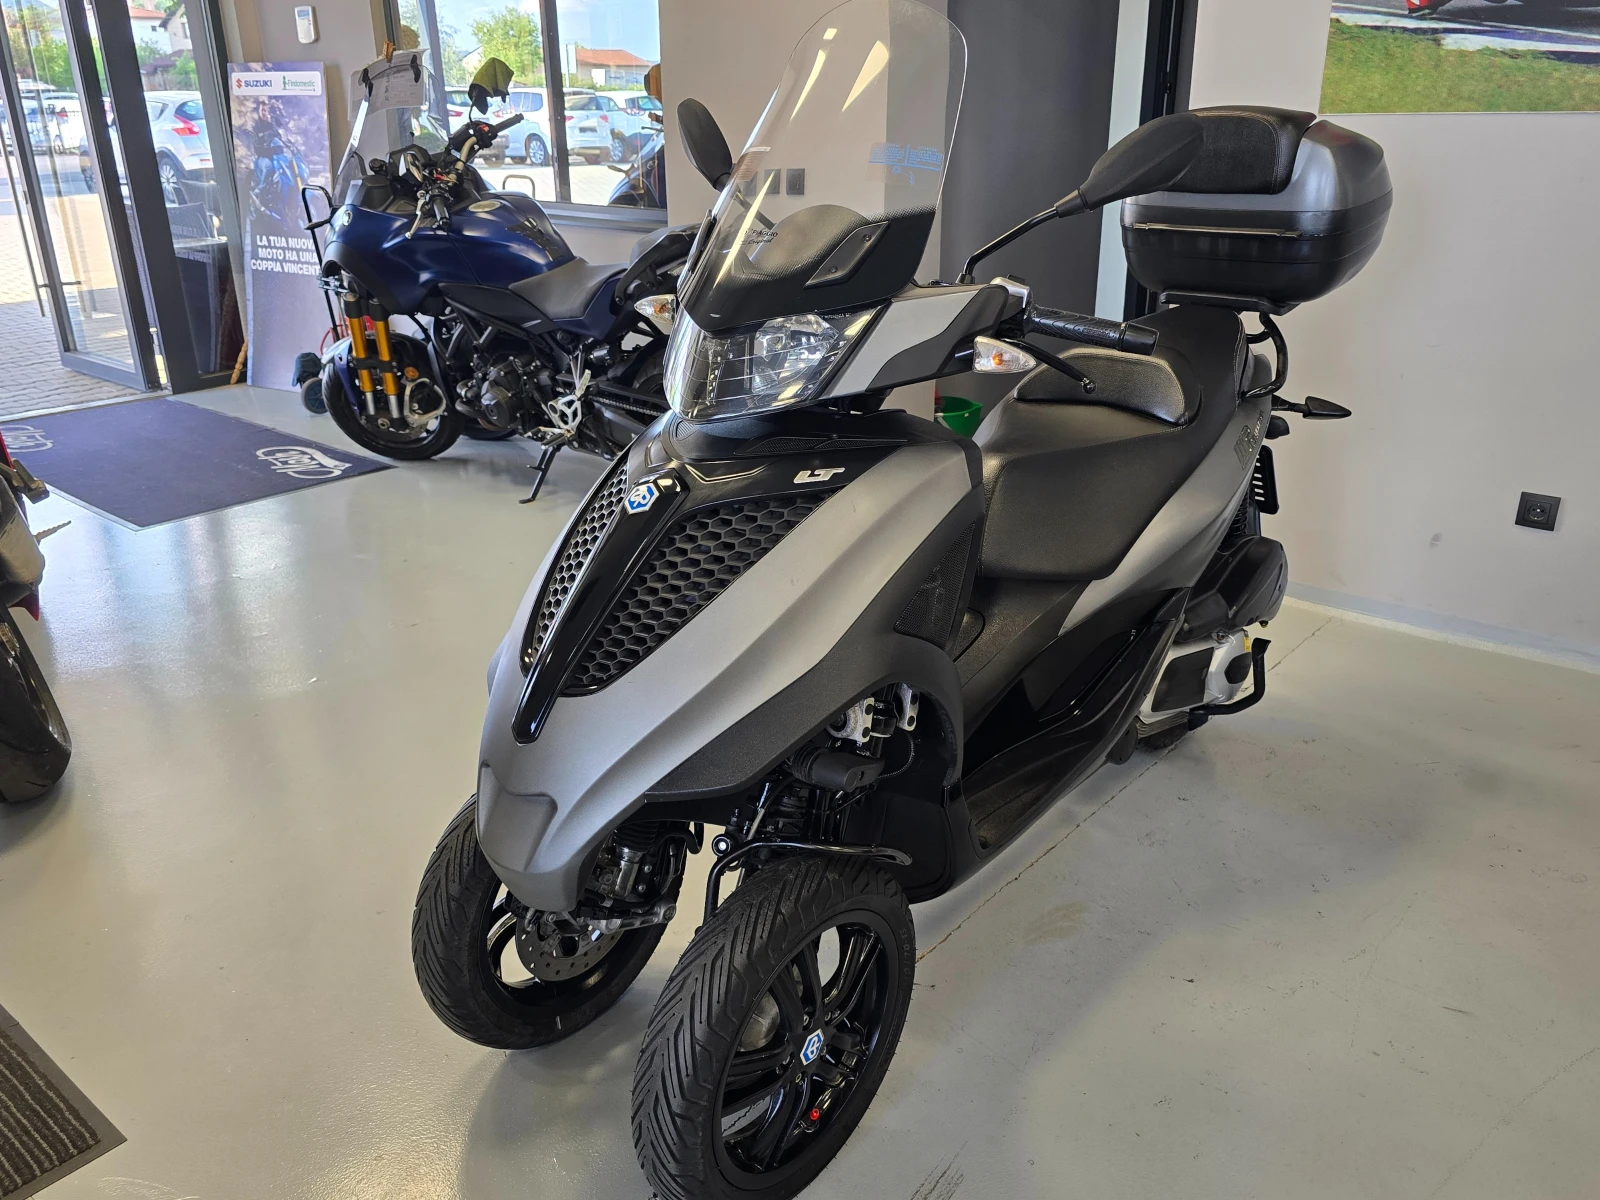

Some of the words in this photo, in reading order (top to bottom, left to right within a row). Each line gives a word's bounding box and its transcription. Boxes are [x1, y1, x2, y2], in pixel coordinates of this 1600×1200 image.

[244, 79, 273, 88] SUZUKI
[287, 79, 316, 88] Findomestic
[752, 229, 778, 237] PIAGGIO
[257, 234, 268, 246] LA
[269, 235, 287, 248] TUA
[258, 247, 284, 260] MOTO
[285, 249, 298, 261] HA
[299, 251, 319, 263] UNA
[251, 260, 282, 272] COPPIA
[283, 262, 320, 275] VINCENT
[793, 467, 846, 484] LT
